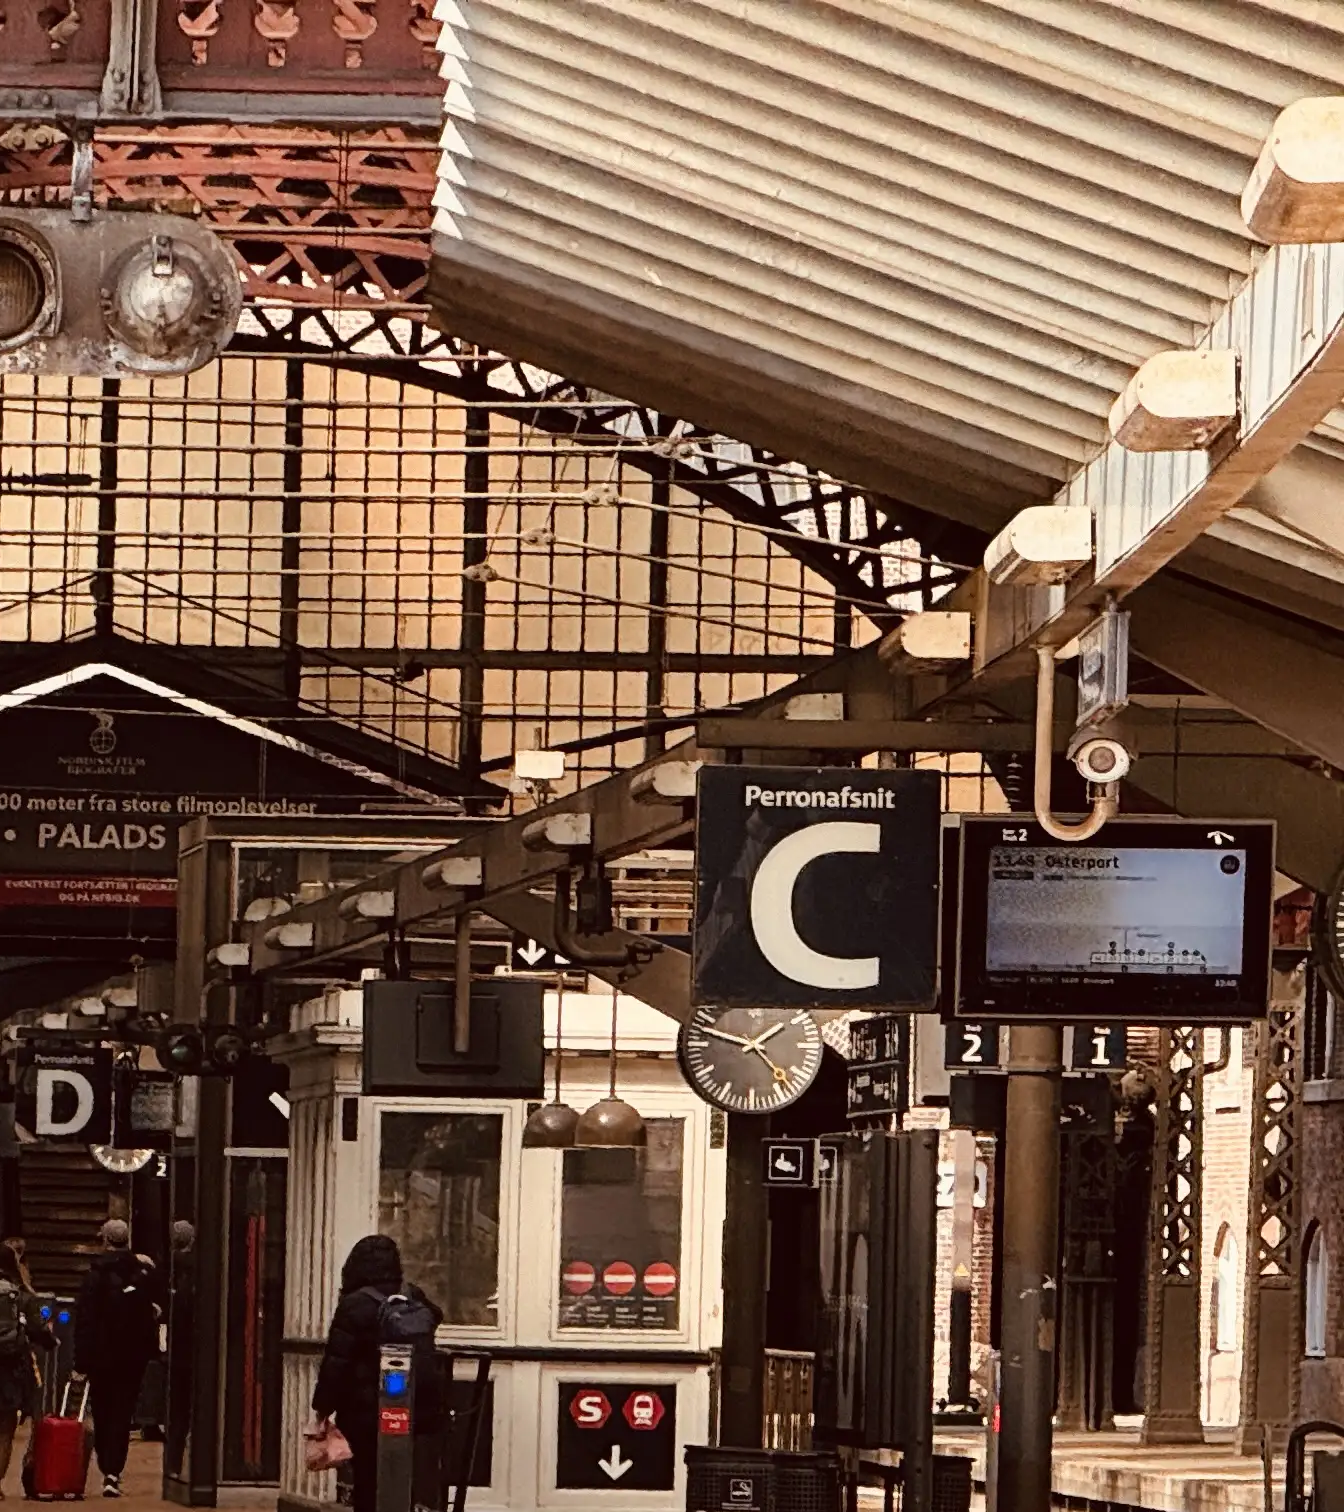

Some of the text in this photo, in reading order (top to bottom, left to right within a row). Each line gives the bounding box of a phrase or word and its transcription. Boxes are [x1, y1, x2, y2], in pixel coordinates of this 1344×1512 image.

[27, 796, 85, 813] meter
[89, 795, 118, 813] fra
[121, 797, 172, 814] store
[176, 796, 318, 815] filmoplevelser
[744, 785, 896, 810] Perronafsnit
[38, 823, 167, 851] PALADS
[750, 821, 882, 990] C
[961, 1033, 983, 1063] 2
[1090, 1036, 1111, 1065] 1
[35, 1068, 95, 1136] D
[155, 1162, 167, 1178] 2
[577, 1396, 603, 1423] S
